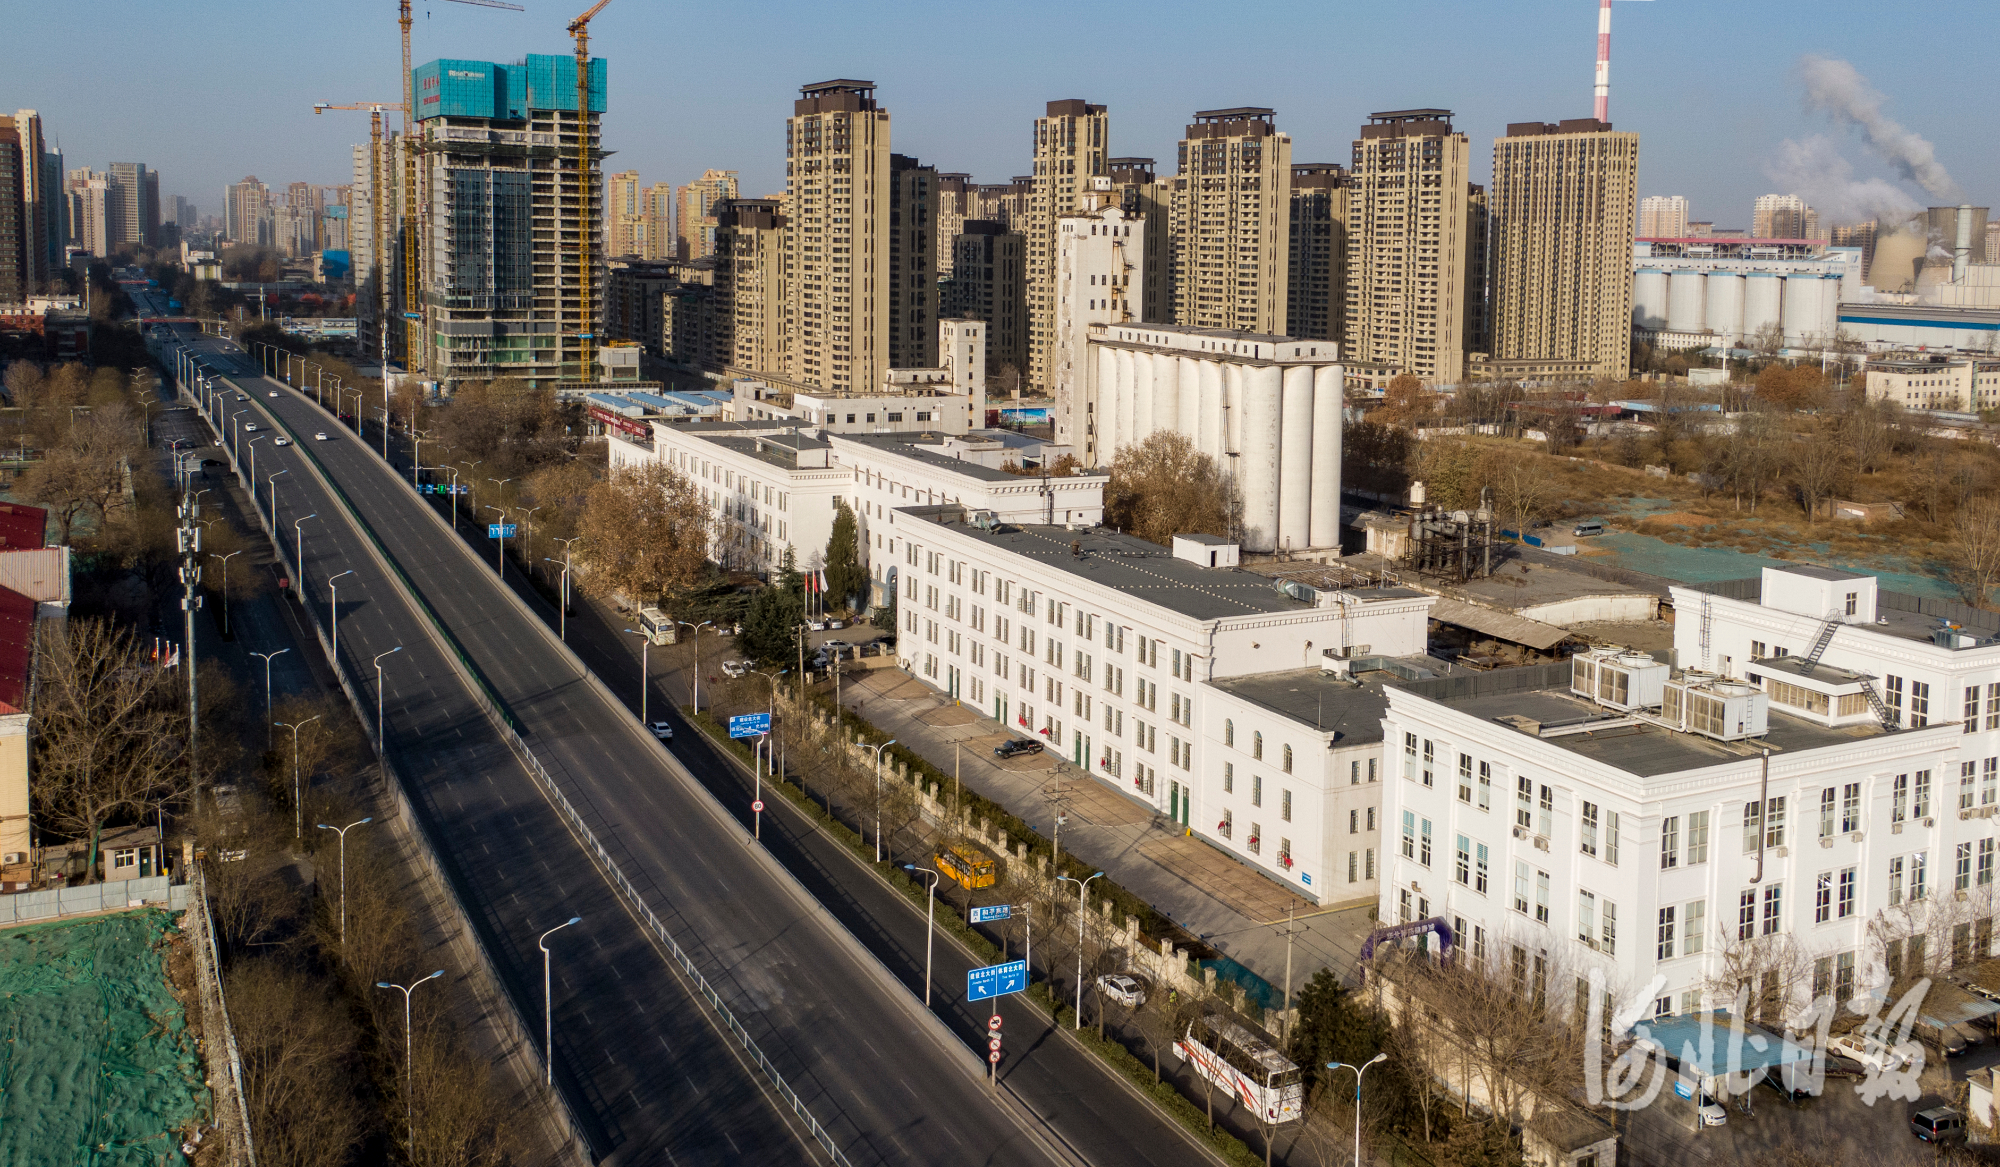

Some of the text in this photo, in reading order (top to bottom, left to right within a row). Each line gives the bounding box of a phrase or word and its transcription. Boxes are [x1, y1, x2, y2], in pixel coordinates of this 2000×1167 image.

[970, 969, 995, 979] 建设北大街
[998, 964, 1023, 974] 体育北大街
